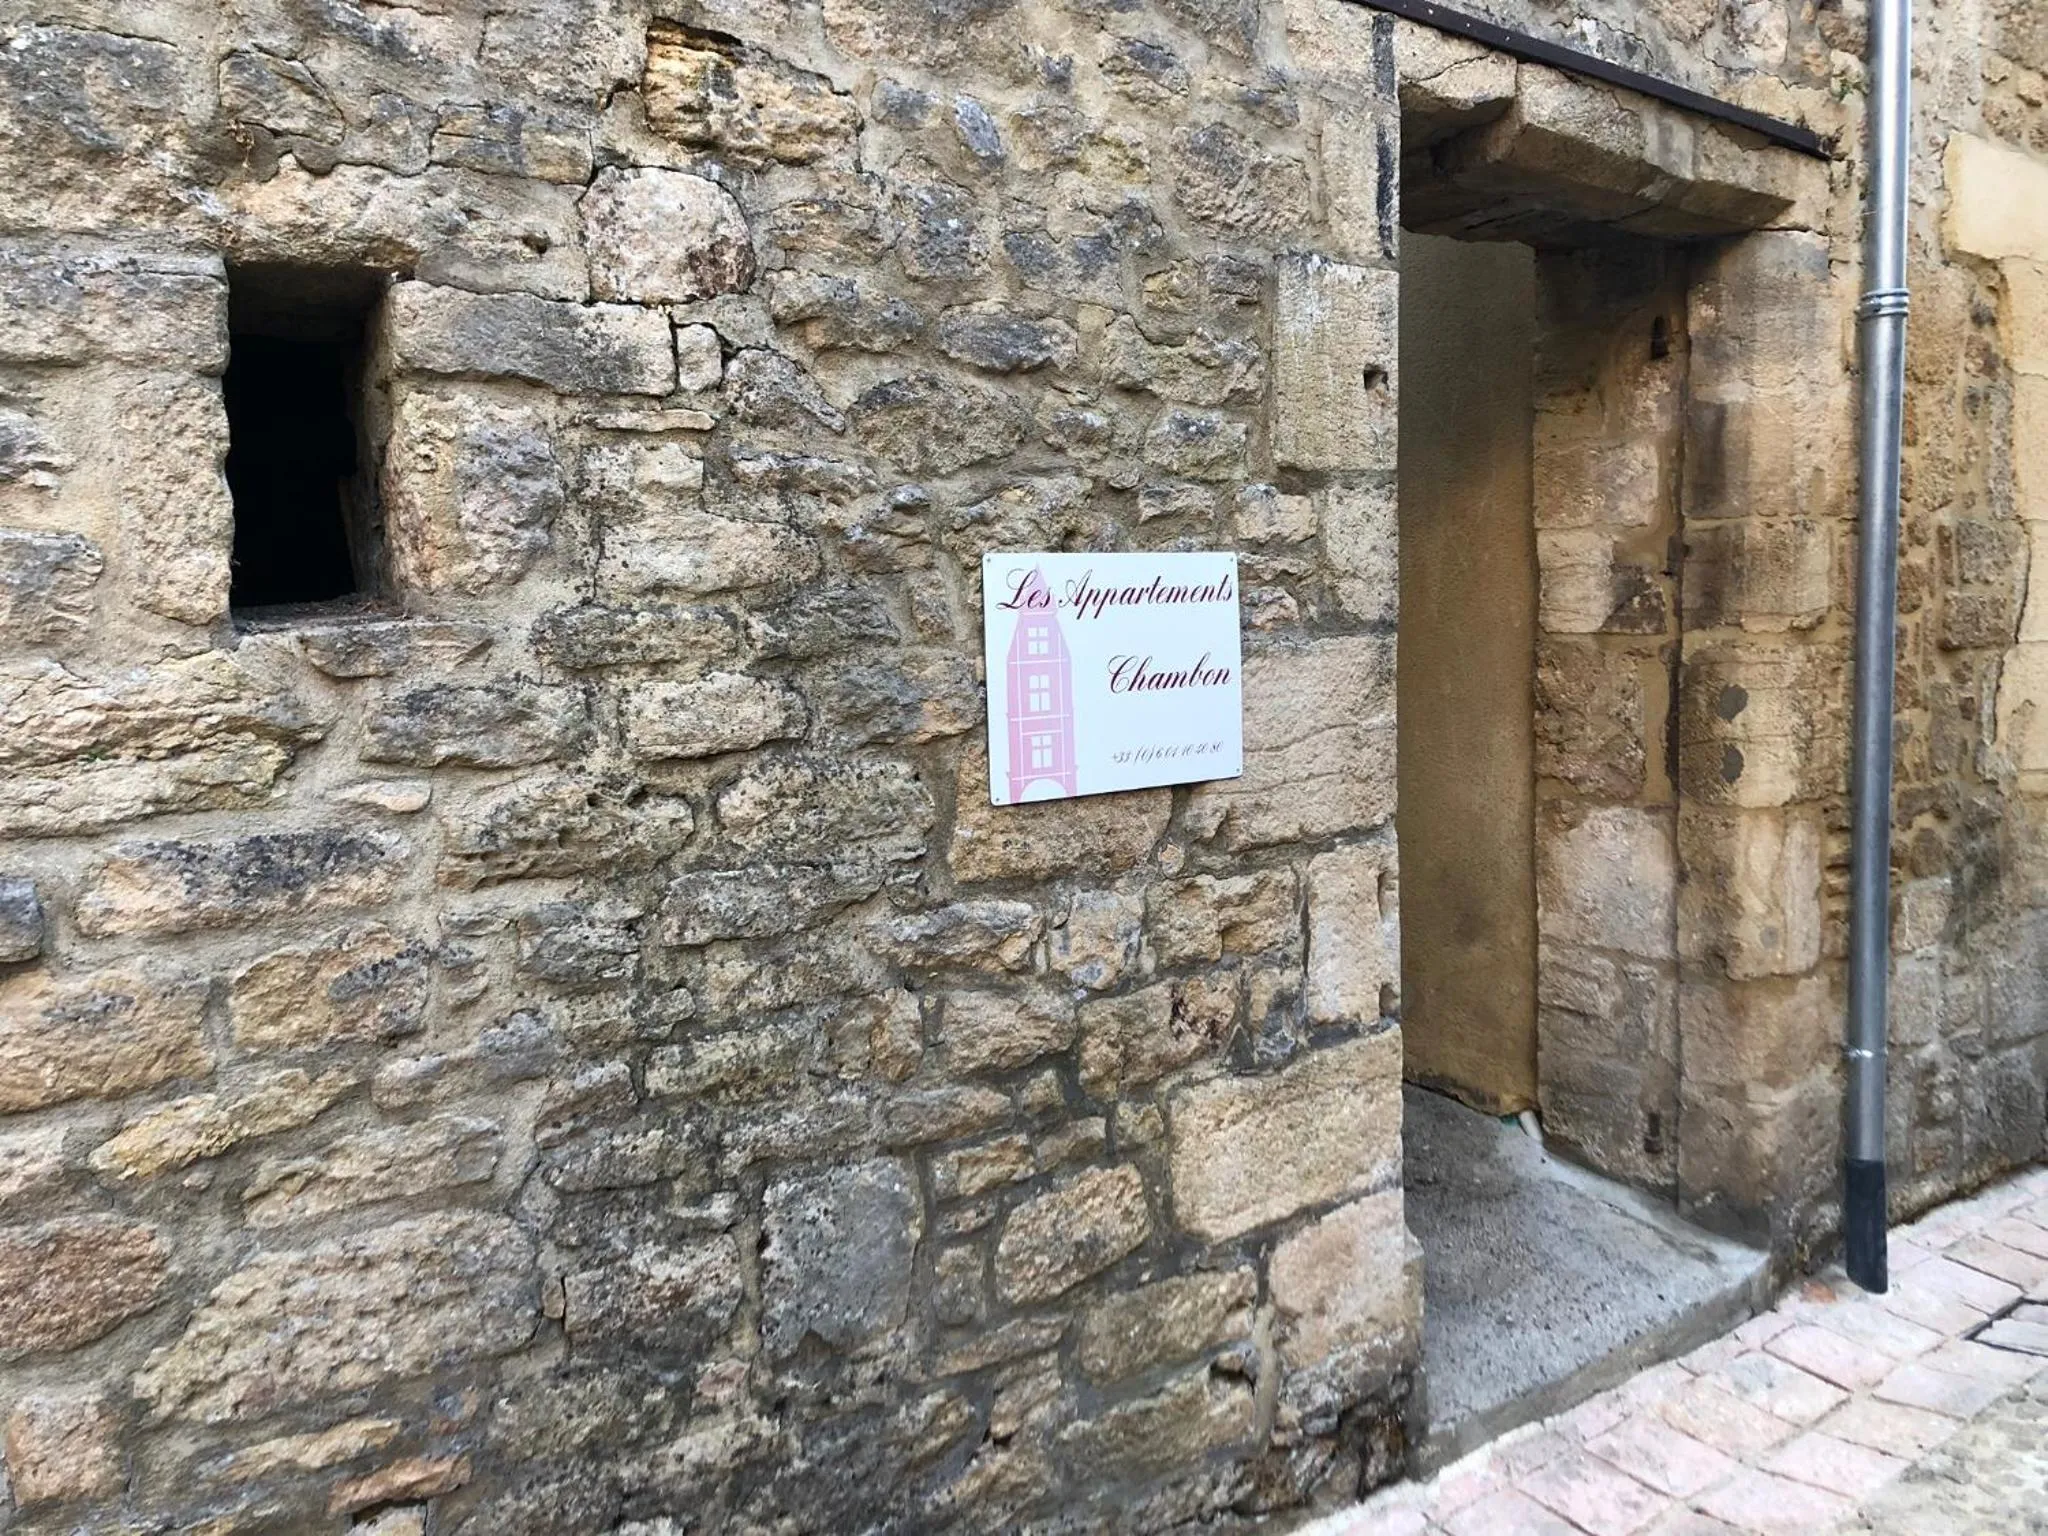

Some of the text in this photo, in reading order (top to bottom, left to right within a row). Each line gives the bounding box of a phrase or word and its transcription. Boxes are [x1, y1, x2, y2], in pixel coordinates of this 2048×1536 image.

[996, 568, 1233, 620] Les Appartements
[1108, 651, 1232, 694] Chambon
